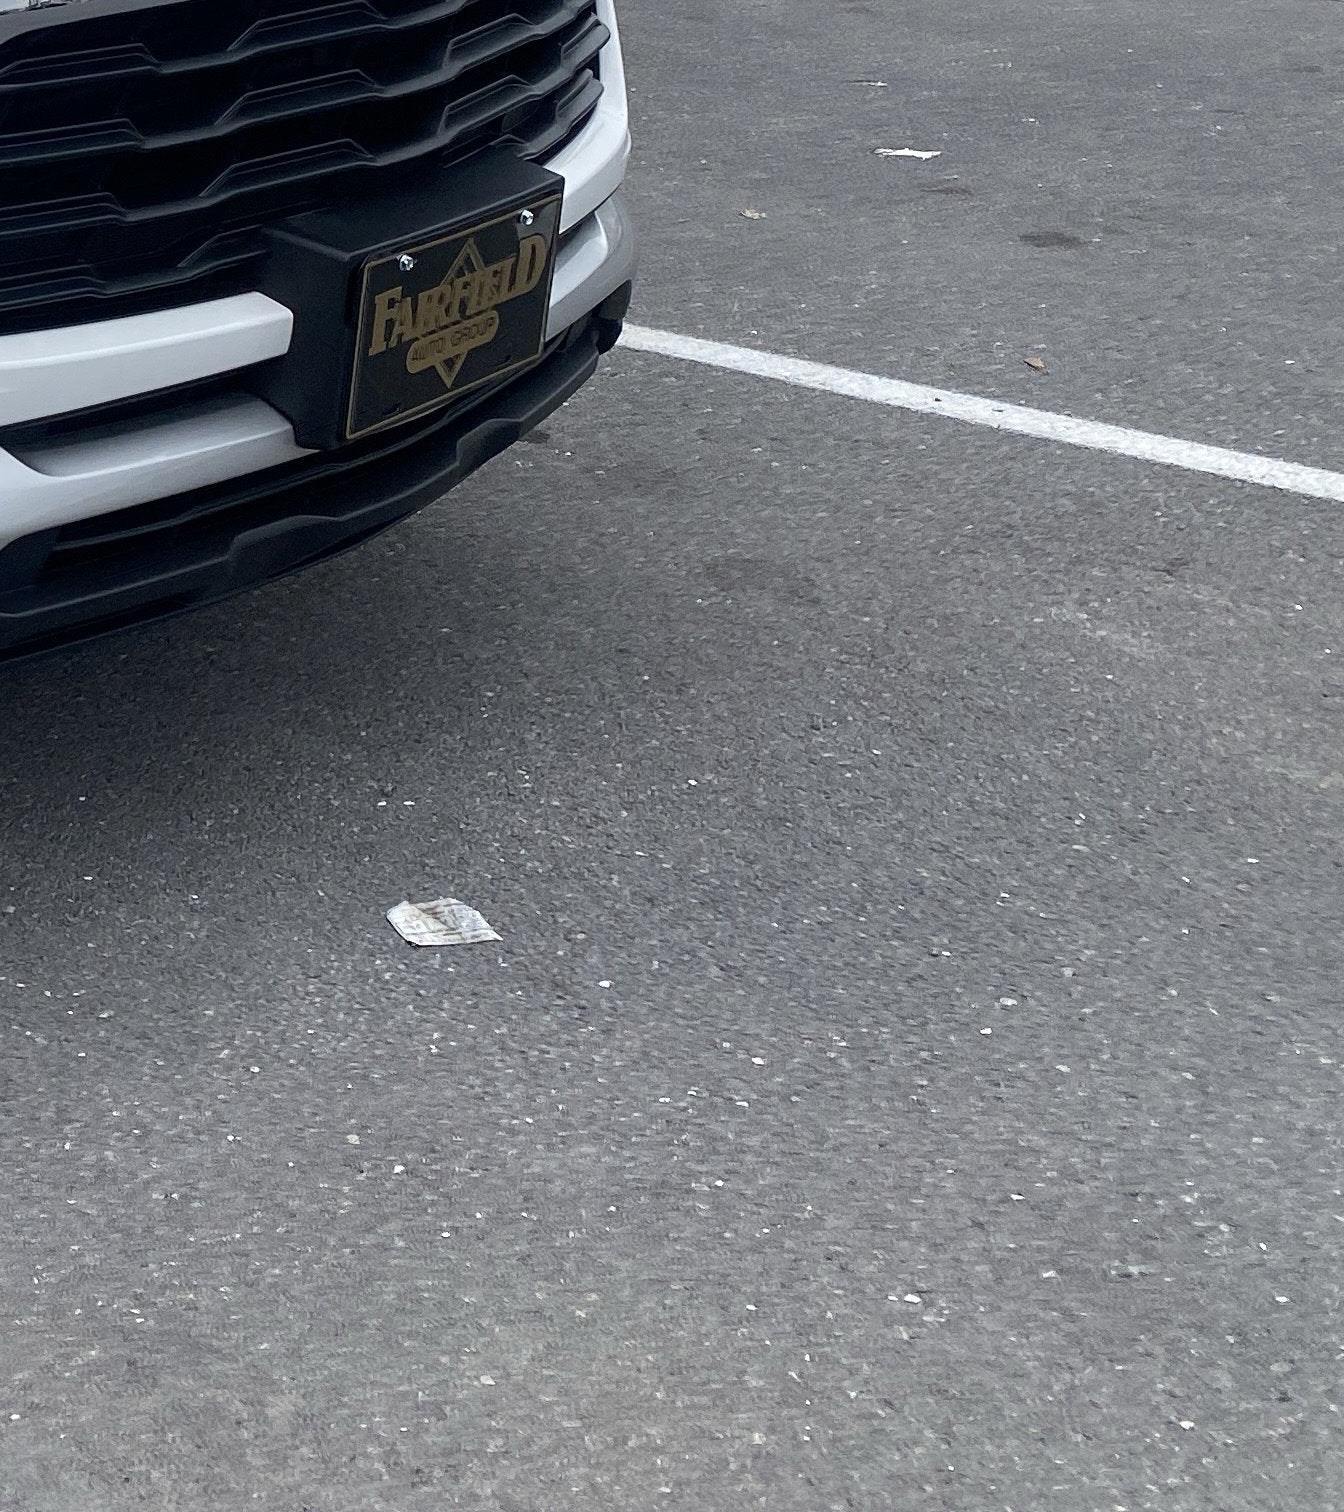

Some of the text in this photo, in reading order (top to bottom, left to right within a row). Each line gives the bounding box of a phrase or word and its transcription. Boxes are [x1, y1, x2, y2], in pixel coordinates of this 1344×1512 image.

[368, 234, 547, 356] FAIRFIELD
[410, 316, 495, 361] AUTO GROUP
